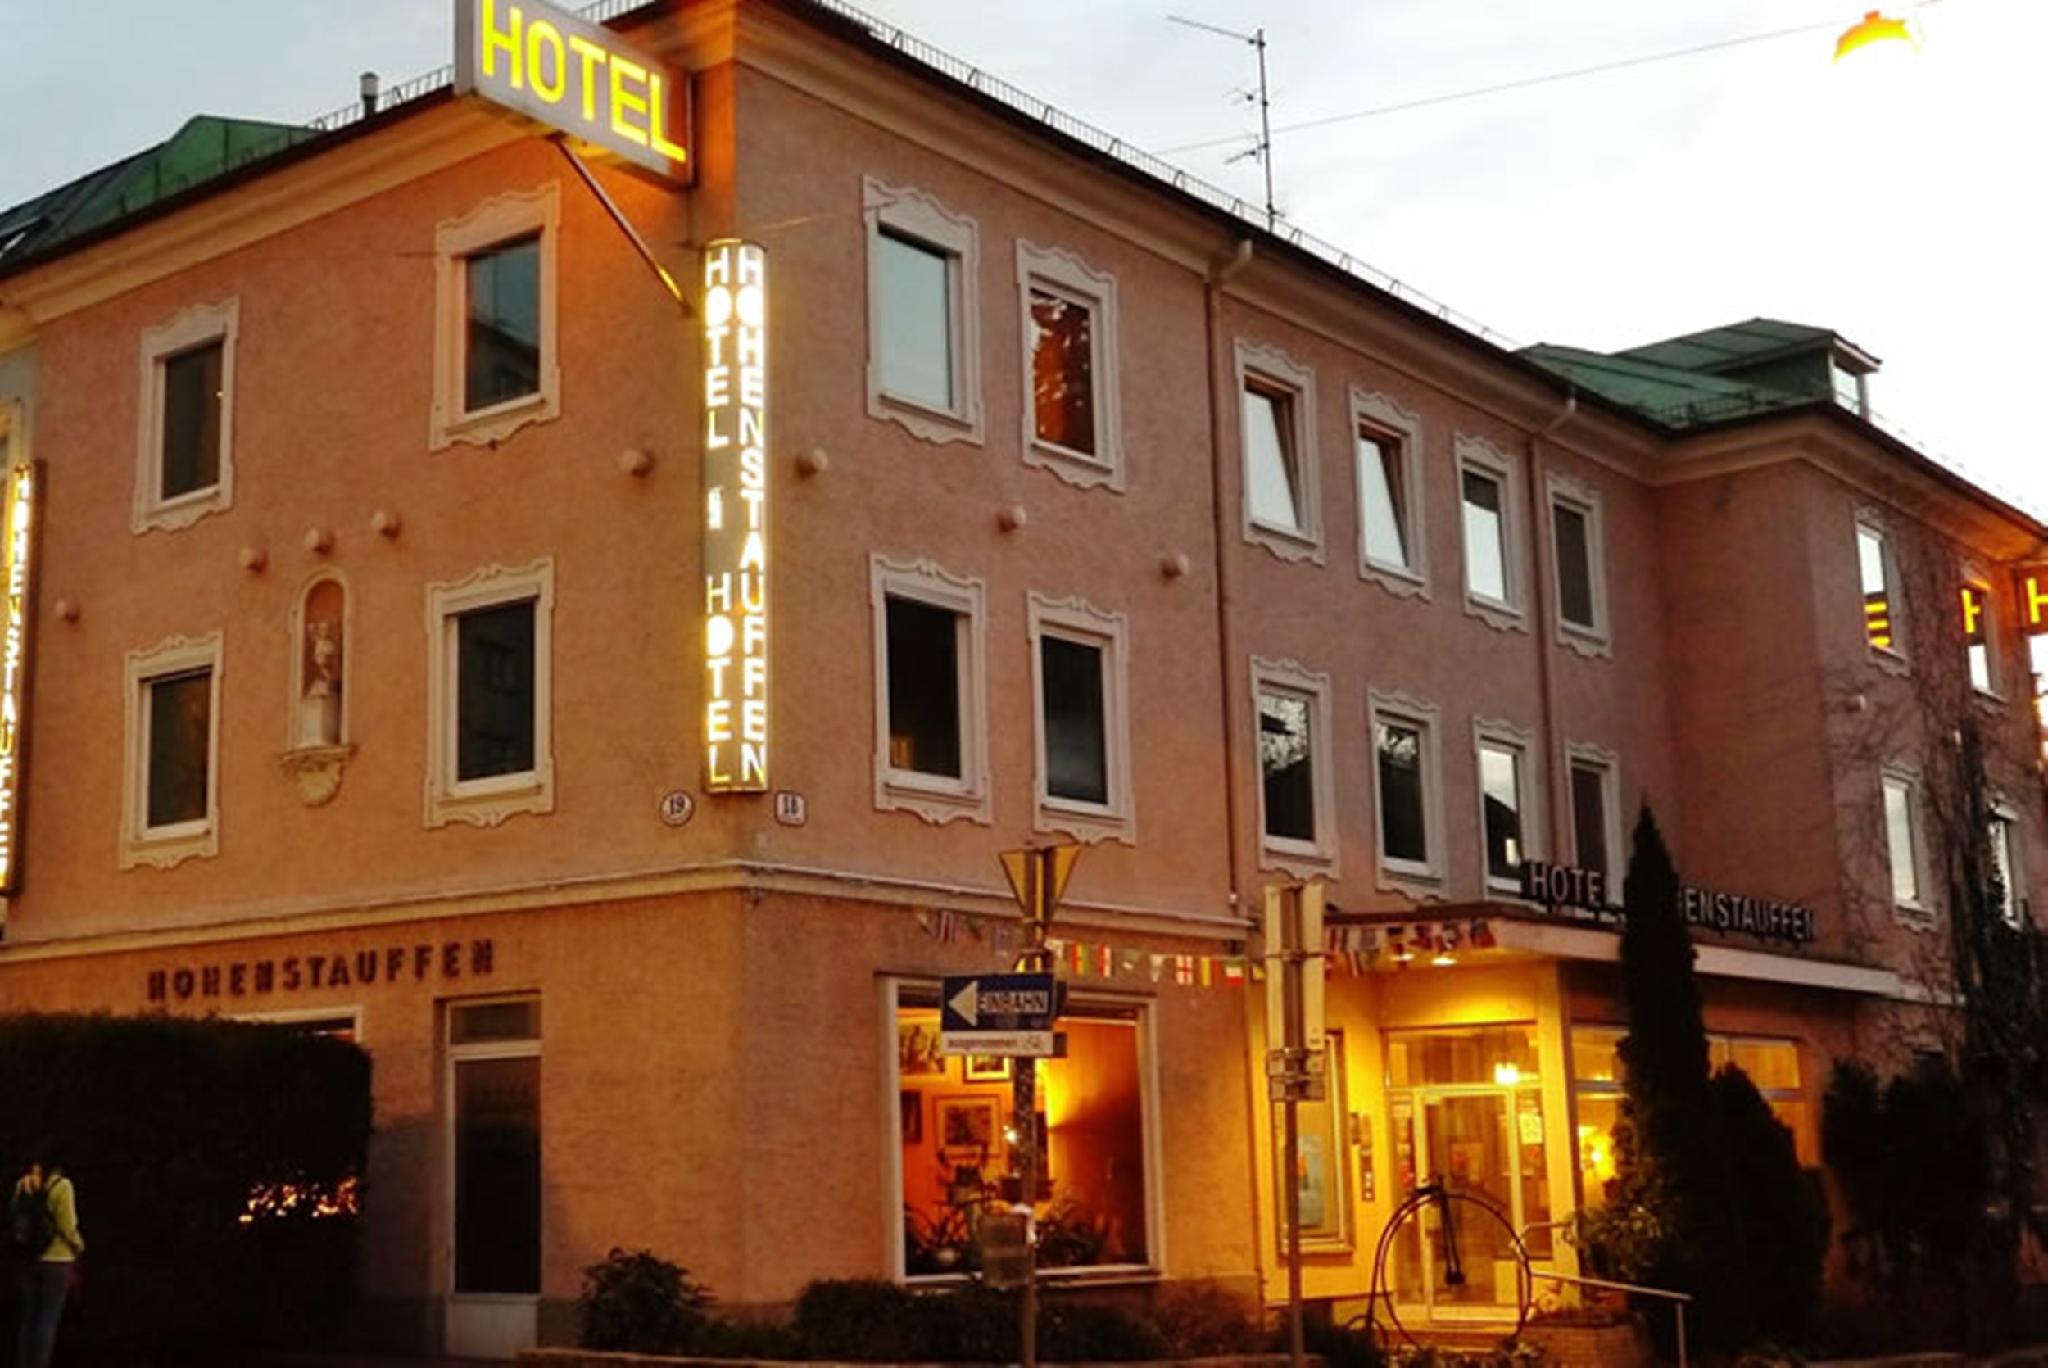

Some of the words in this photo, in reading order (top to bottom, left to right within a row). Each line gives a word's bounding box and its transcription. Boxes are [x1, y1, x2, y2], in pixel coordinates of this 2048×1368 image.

[482, 0, 687, 162] HOTEL
[705, 245, 732, 449] HOTEL
[737, 245, 767, 783] HOHENSTAUFFEN
[706, 572, 733, 782] HOTEL
[669, 795, 686, 815] 19
[147, 938, 494, 1002] HOHENSTAUFFEN
